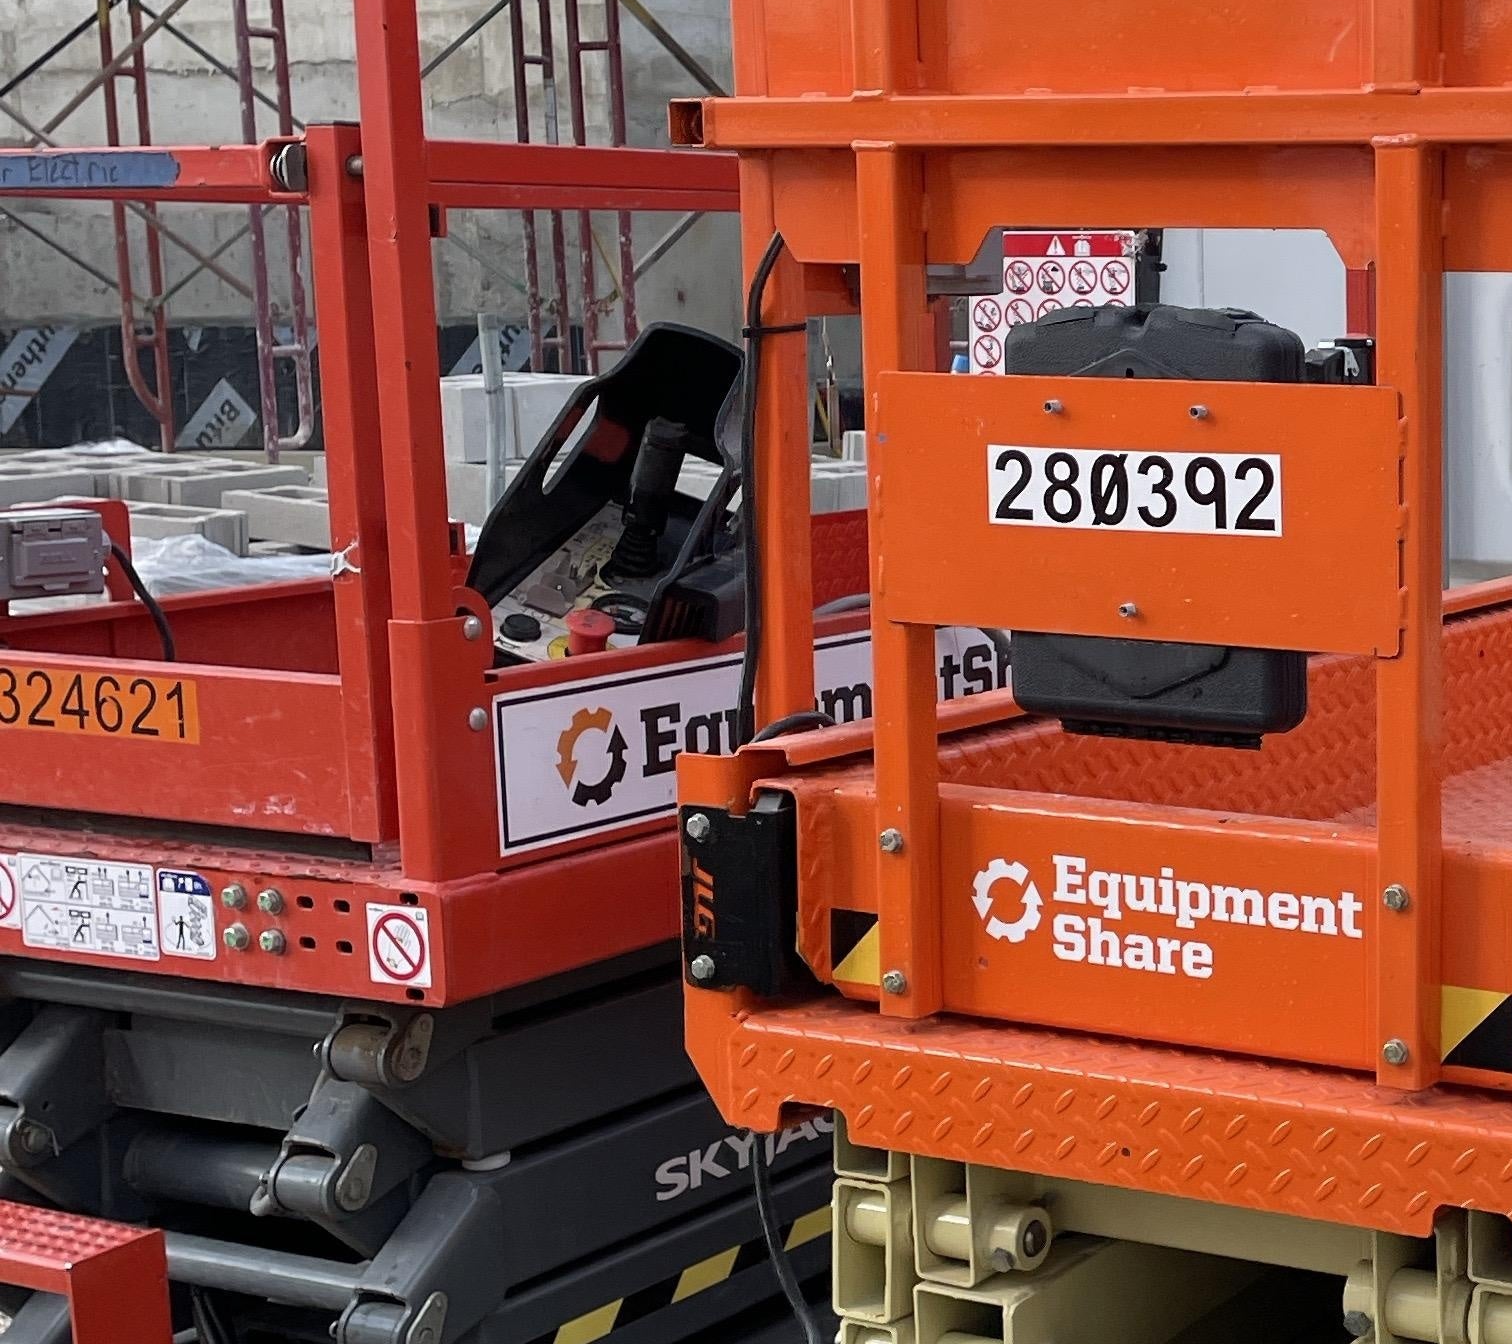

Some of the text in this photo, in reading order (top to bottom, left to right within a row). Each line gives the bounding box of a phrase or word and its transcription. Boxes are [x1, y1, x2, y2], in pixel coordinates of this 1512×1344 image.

[994, 449, 1277, 532] 280392
[1052, 854, 1363, 939] Equipment
[1052, 913, 1214, 980] Share
